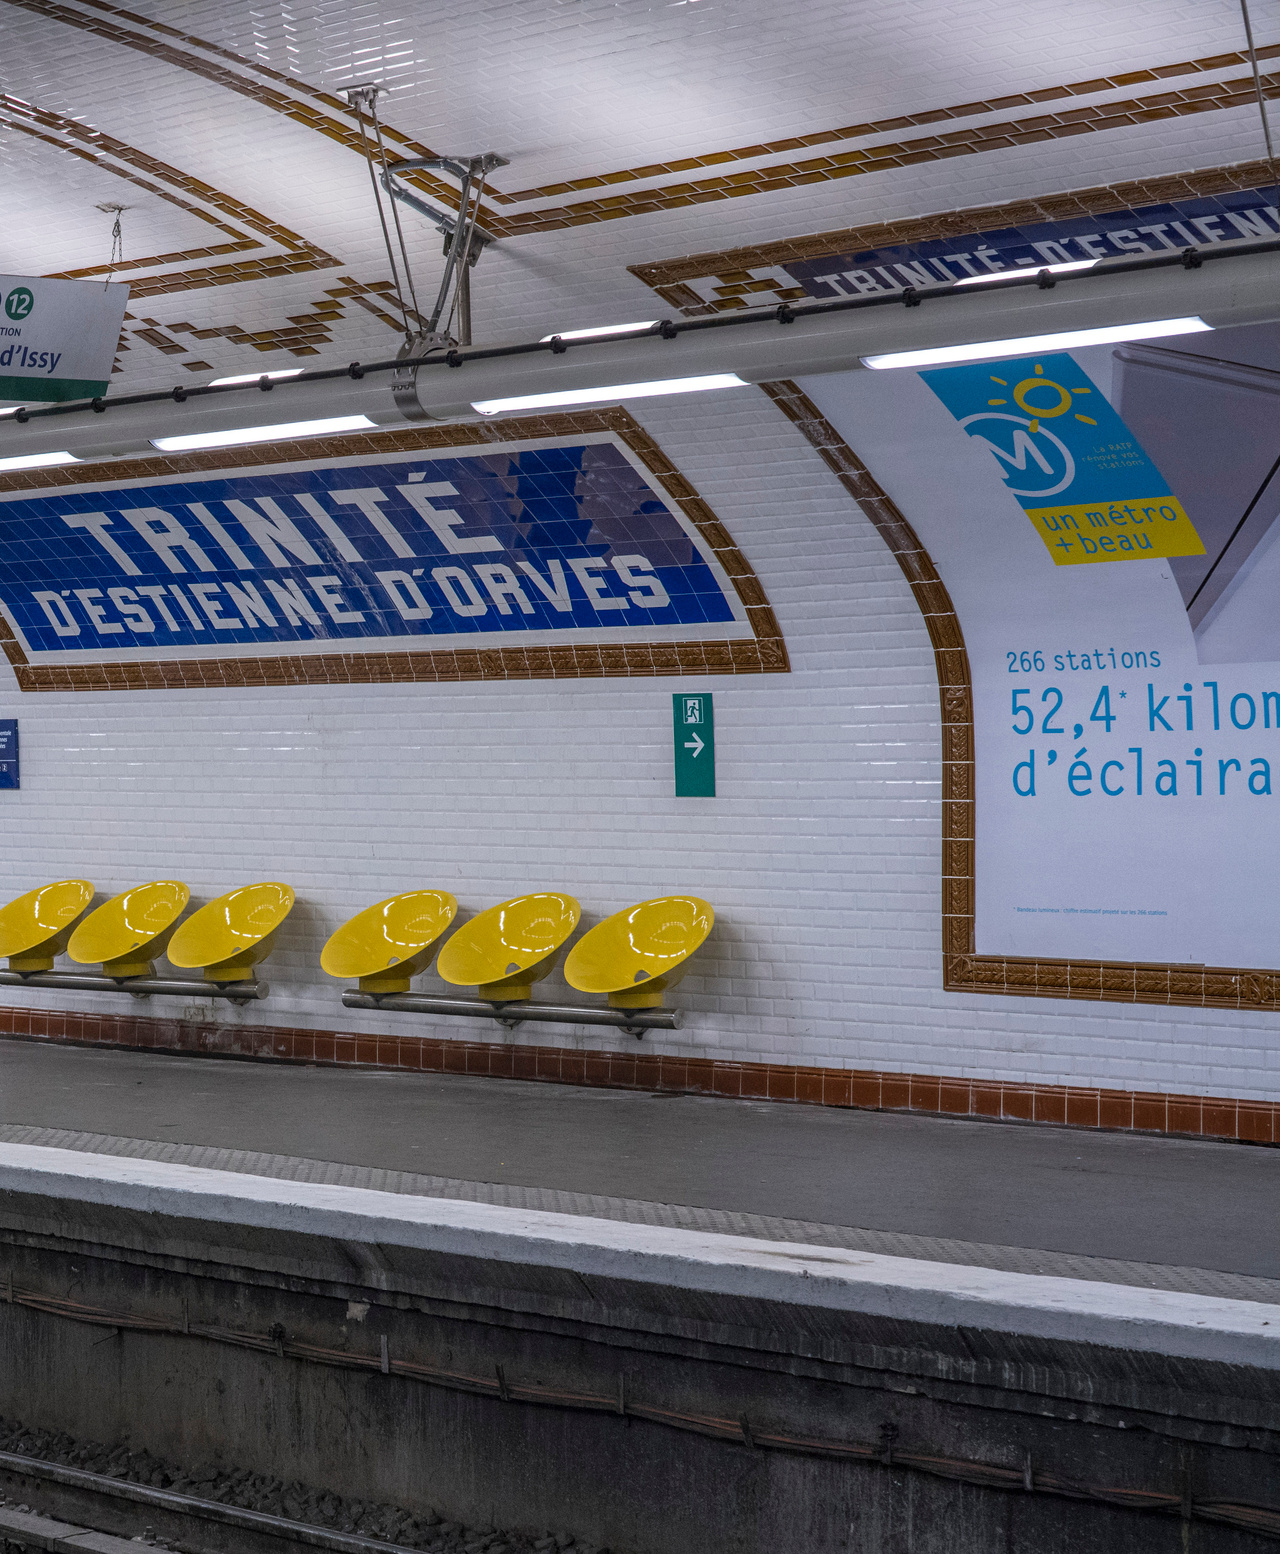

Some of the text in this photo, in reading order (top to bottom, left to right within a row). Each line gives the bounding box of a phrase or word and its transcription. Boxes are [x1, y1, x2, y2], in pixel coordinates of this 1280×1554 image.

[814, 245, 1006, 298] TRINITÉ
[9, 293, 30, 315] 12
[0, 345, 62, 374] d'Issy
[61, 472, 507, 577] TRINITÉ
[1042, 504, 1177, 531] un métro
[1077, 532, 1153, 554] beau
[31, 554, 672, 639] D'ESTIENNE D'ORVES
[1006, 647, 1161, 673] 266 stations
[1012, 747, 1272, 797] d'éclaira
